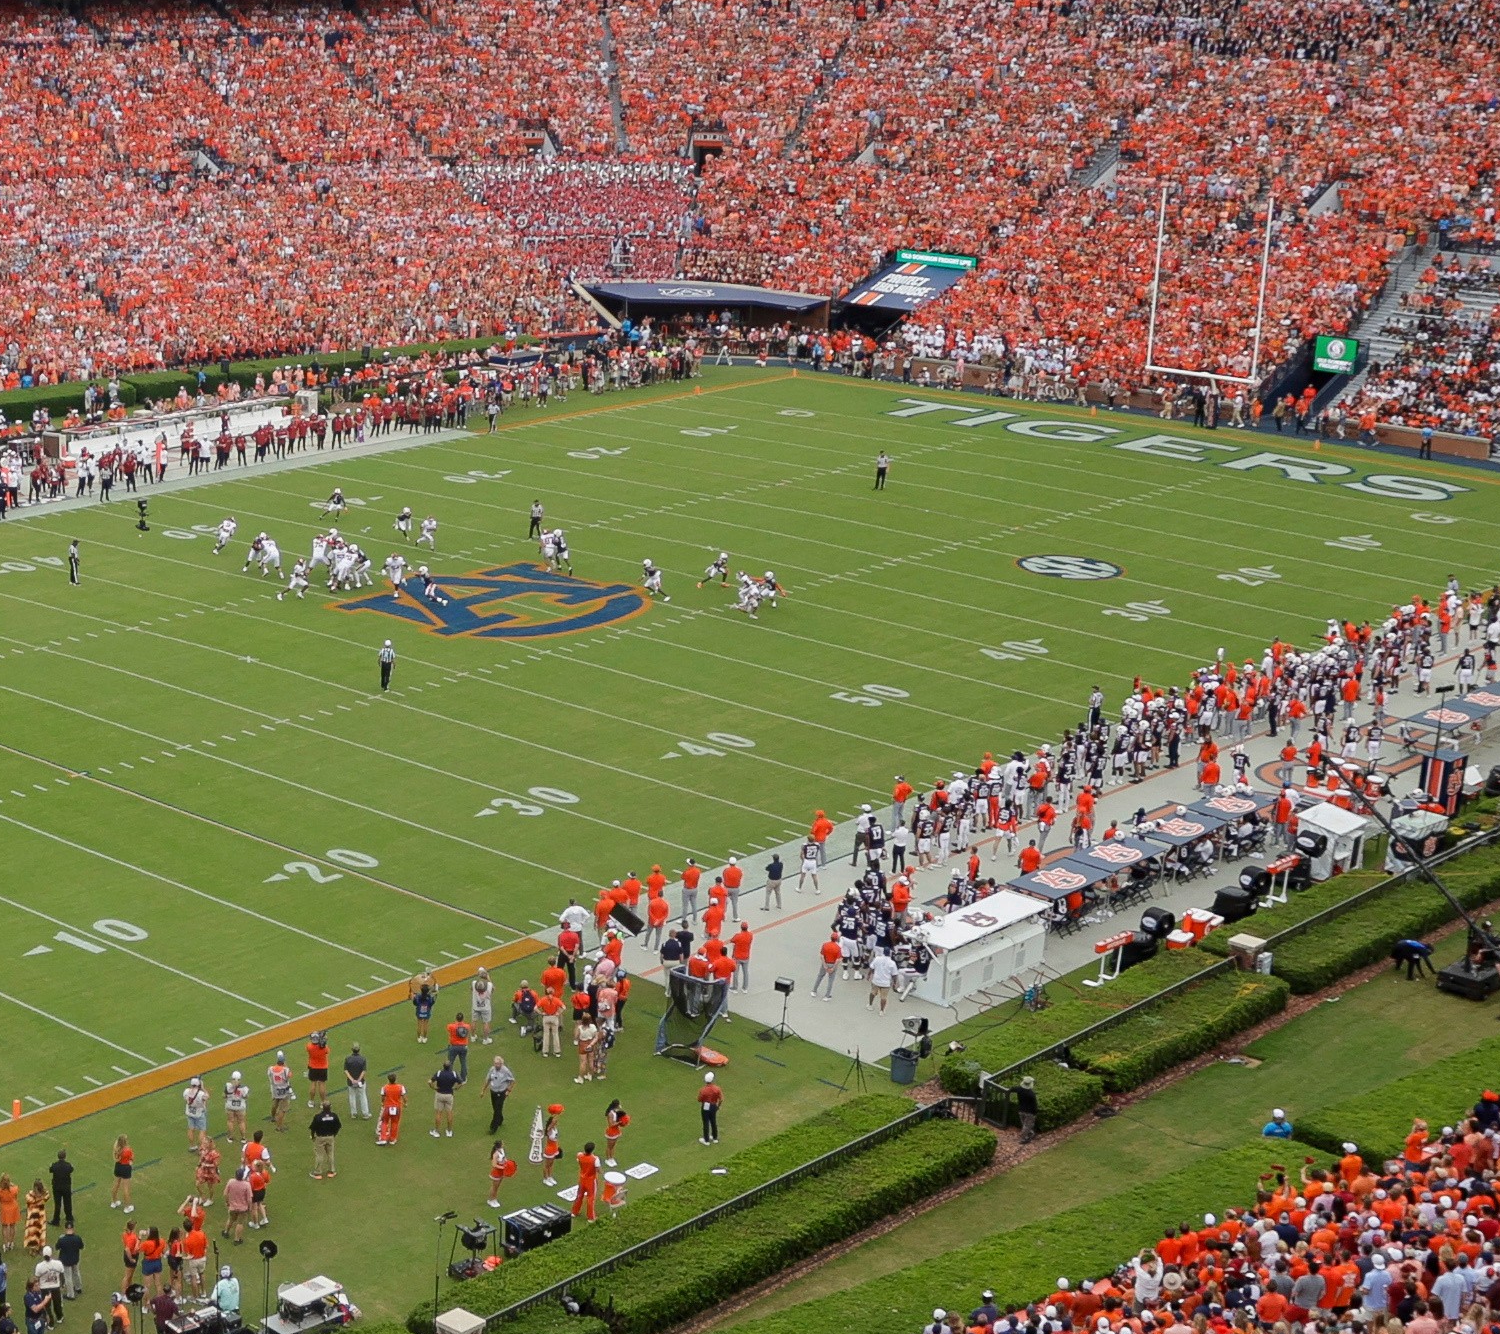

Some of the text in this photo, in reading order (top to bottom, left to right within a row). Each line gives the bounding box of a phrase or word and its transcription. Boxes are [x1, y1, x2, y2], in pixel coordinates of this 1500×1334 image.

[884, 396, 1470, 503] TIGERS
[980, 641, 1049, 661] 40
[829, 684, 911, 707] 50
[678, 731, 756, 757] 40
[491, 786, 580, 816] 30
[284, 849, 379, 884] 20
[53, 919, 149, 954] 10
